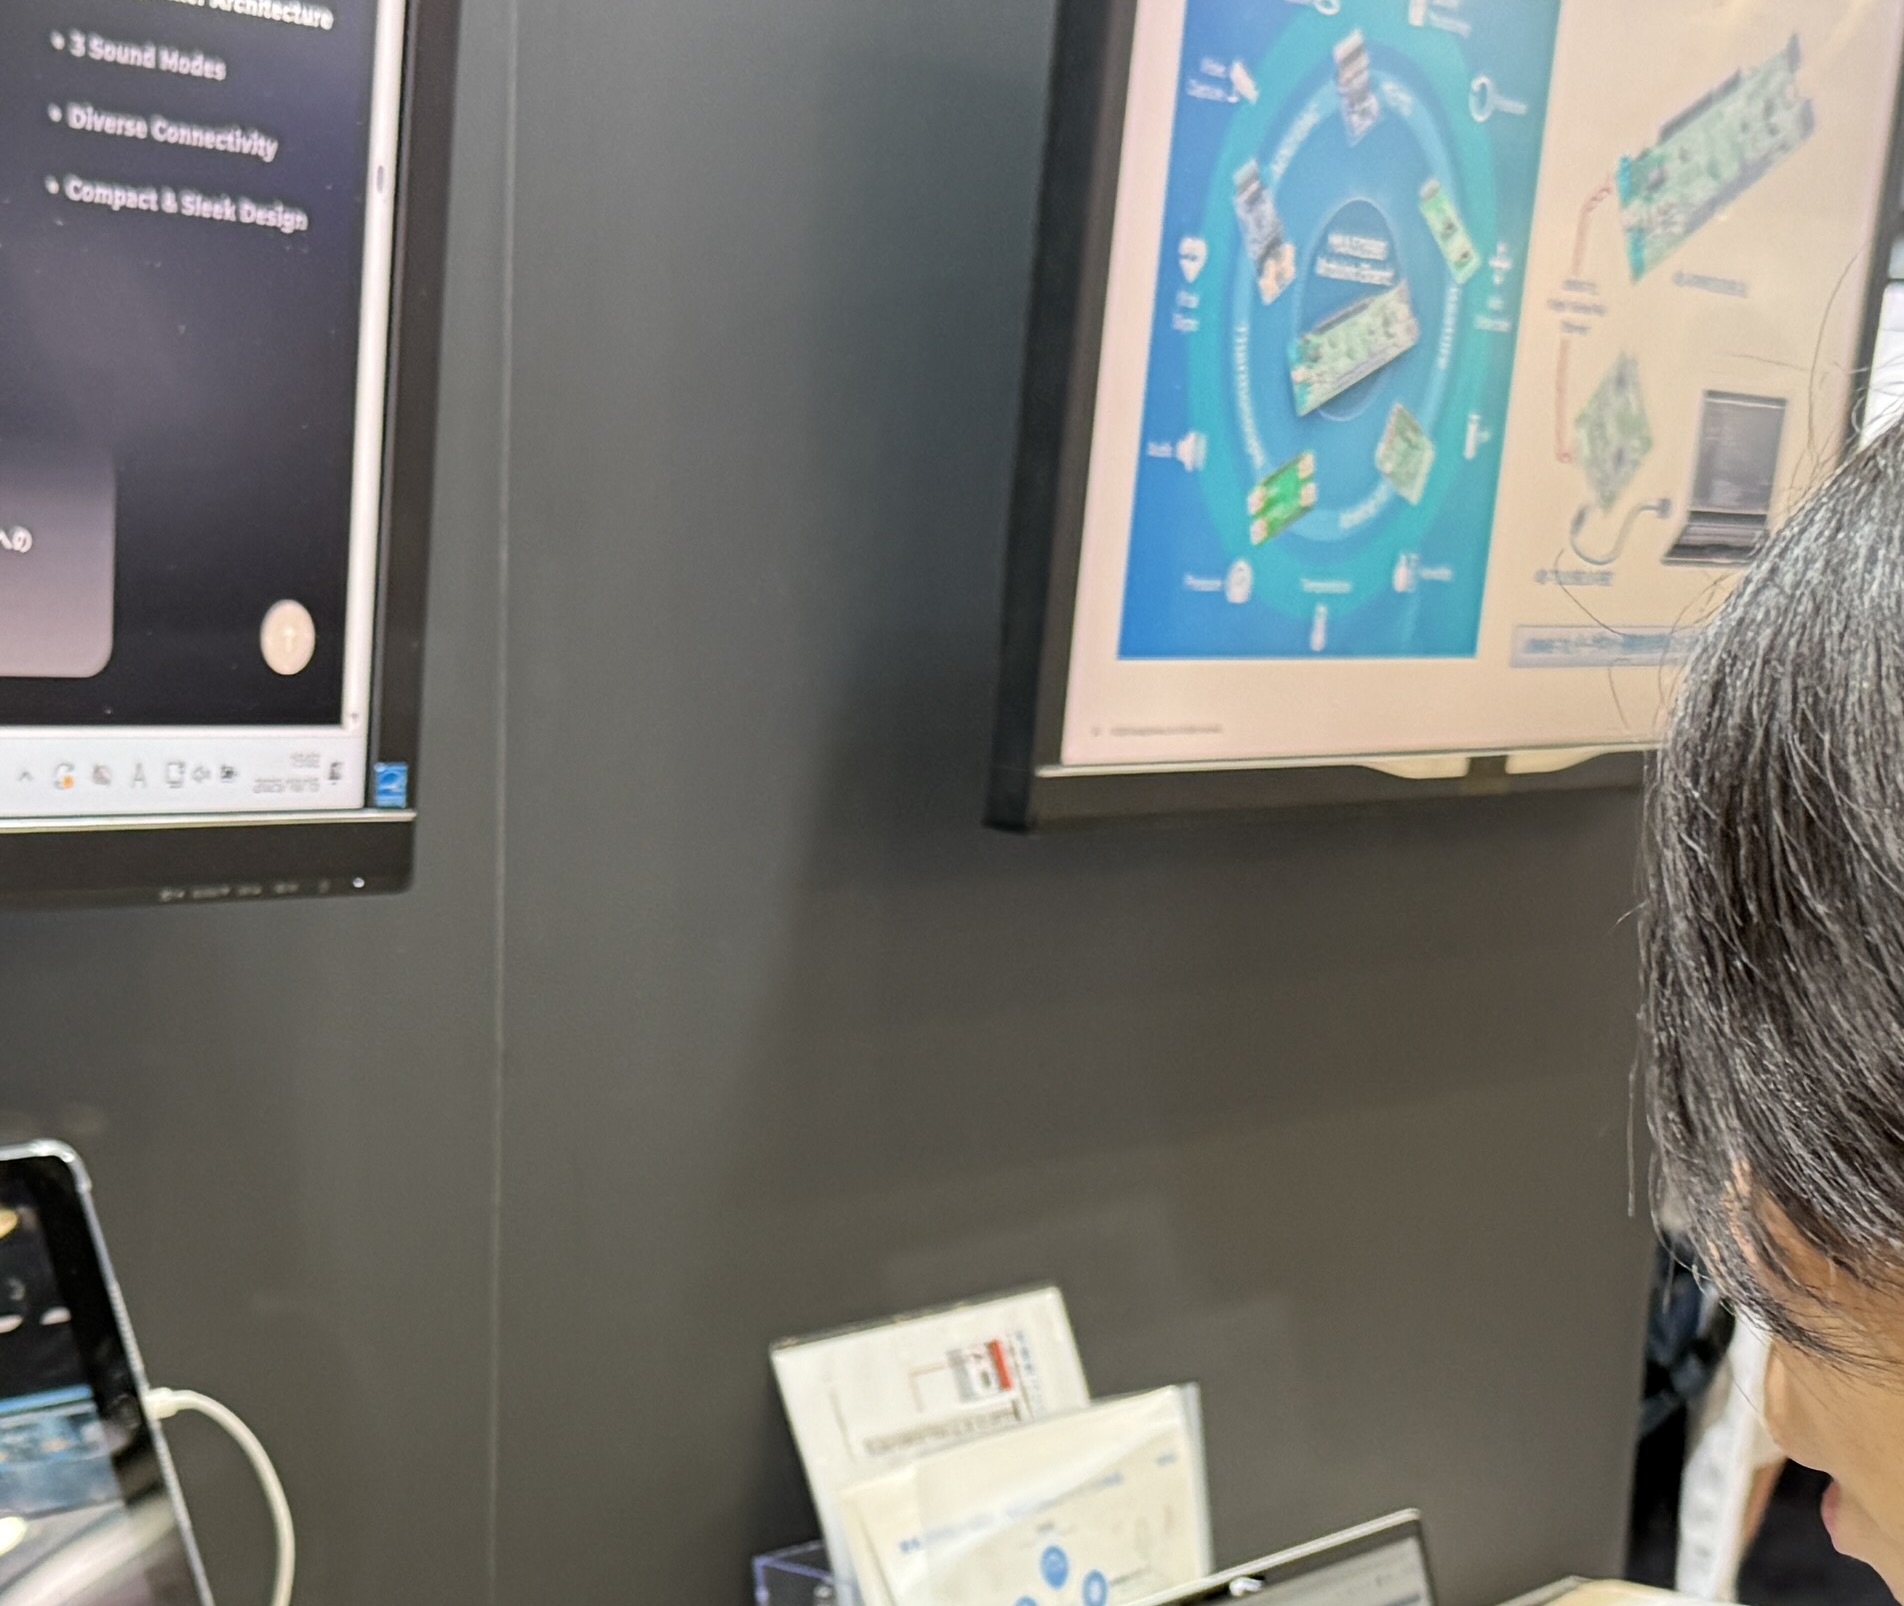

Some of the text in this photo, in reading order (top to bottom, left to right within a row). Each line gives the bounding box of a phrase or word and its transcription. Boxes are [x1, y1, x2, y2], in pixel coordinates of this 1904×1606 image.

[69, 29, 227, 81] 3 Sound Modes
[66, 102, 279, 163] Diverse Connectivity
[63, 174, 309, 235] Compact & Sleek Design
